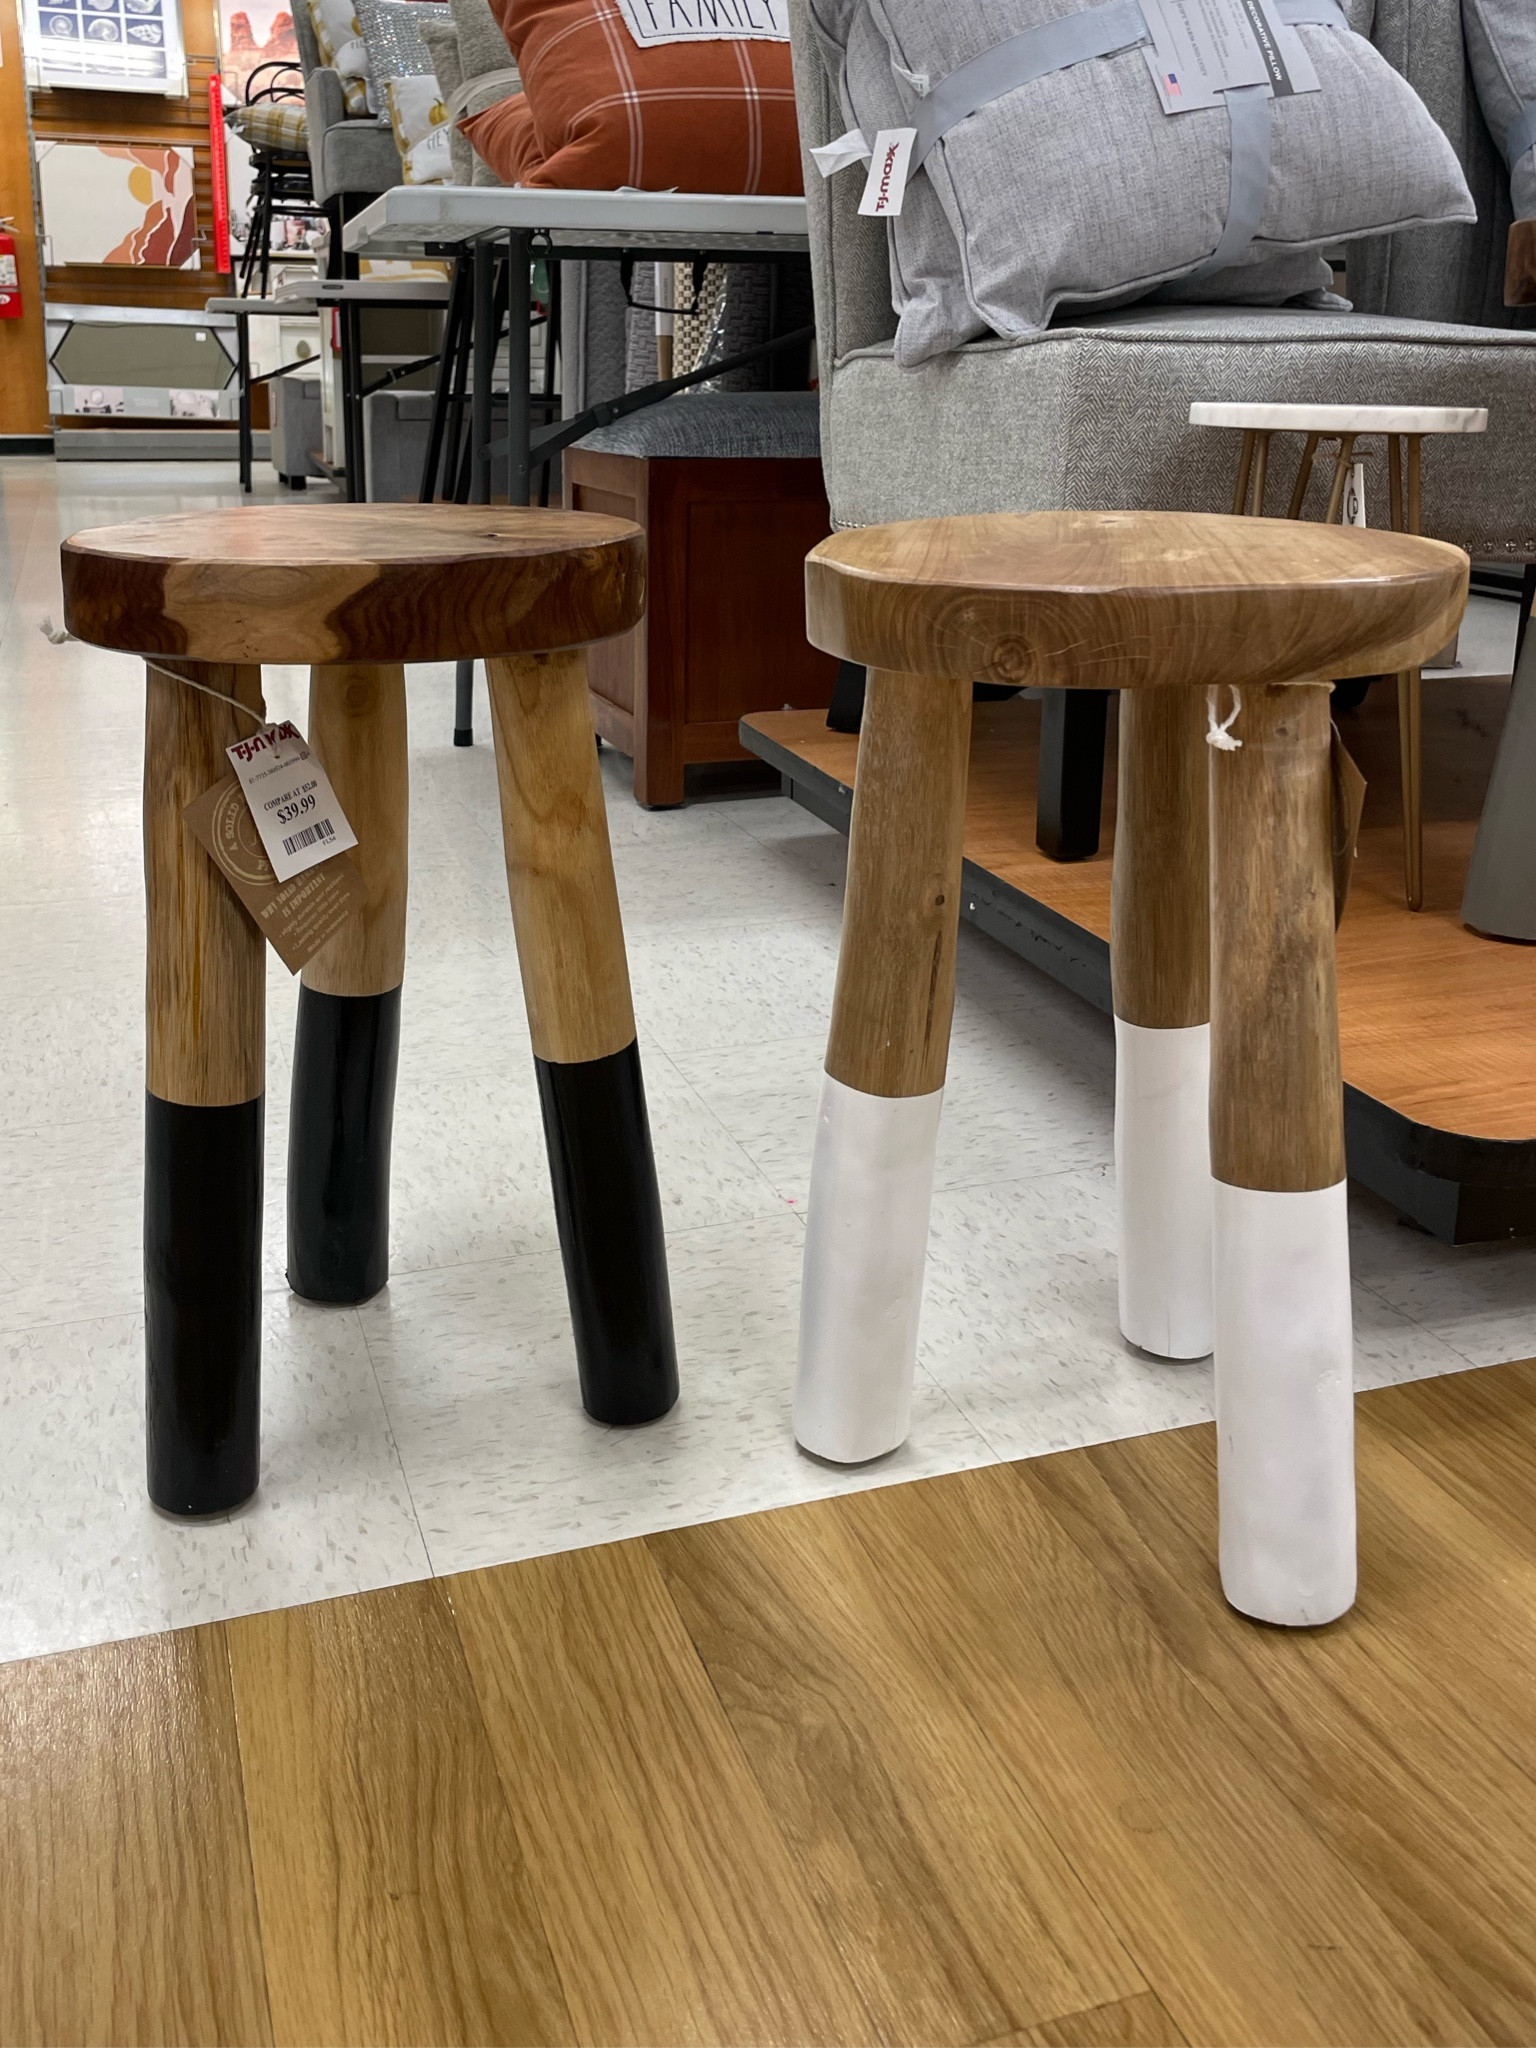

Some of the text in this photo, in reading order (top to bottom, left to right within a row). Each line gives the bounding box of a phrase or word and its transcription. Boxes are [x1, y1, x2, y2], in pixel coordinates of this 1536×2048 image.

[644, 0, 777, 30] FAMILY
[1246, 0, 1283, 82] DECORATIVE PILLOW
[263, 788, 293, 811] COMPARE
[291, 787, 302, 799] AT
[277, 794, 316, 825] $39.99
[225, 802, 240, 839] SOLID
[260, 883, 297, 919] WHY SOLID
[282, 906, 292, 918] IS
[289, 872, 326, 911] IMPORTANT
